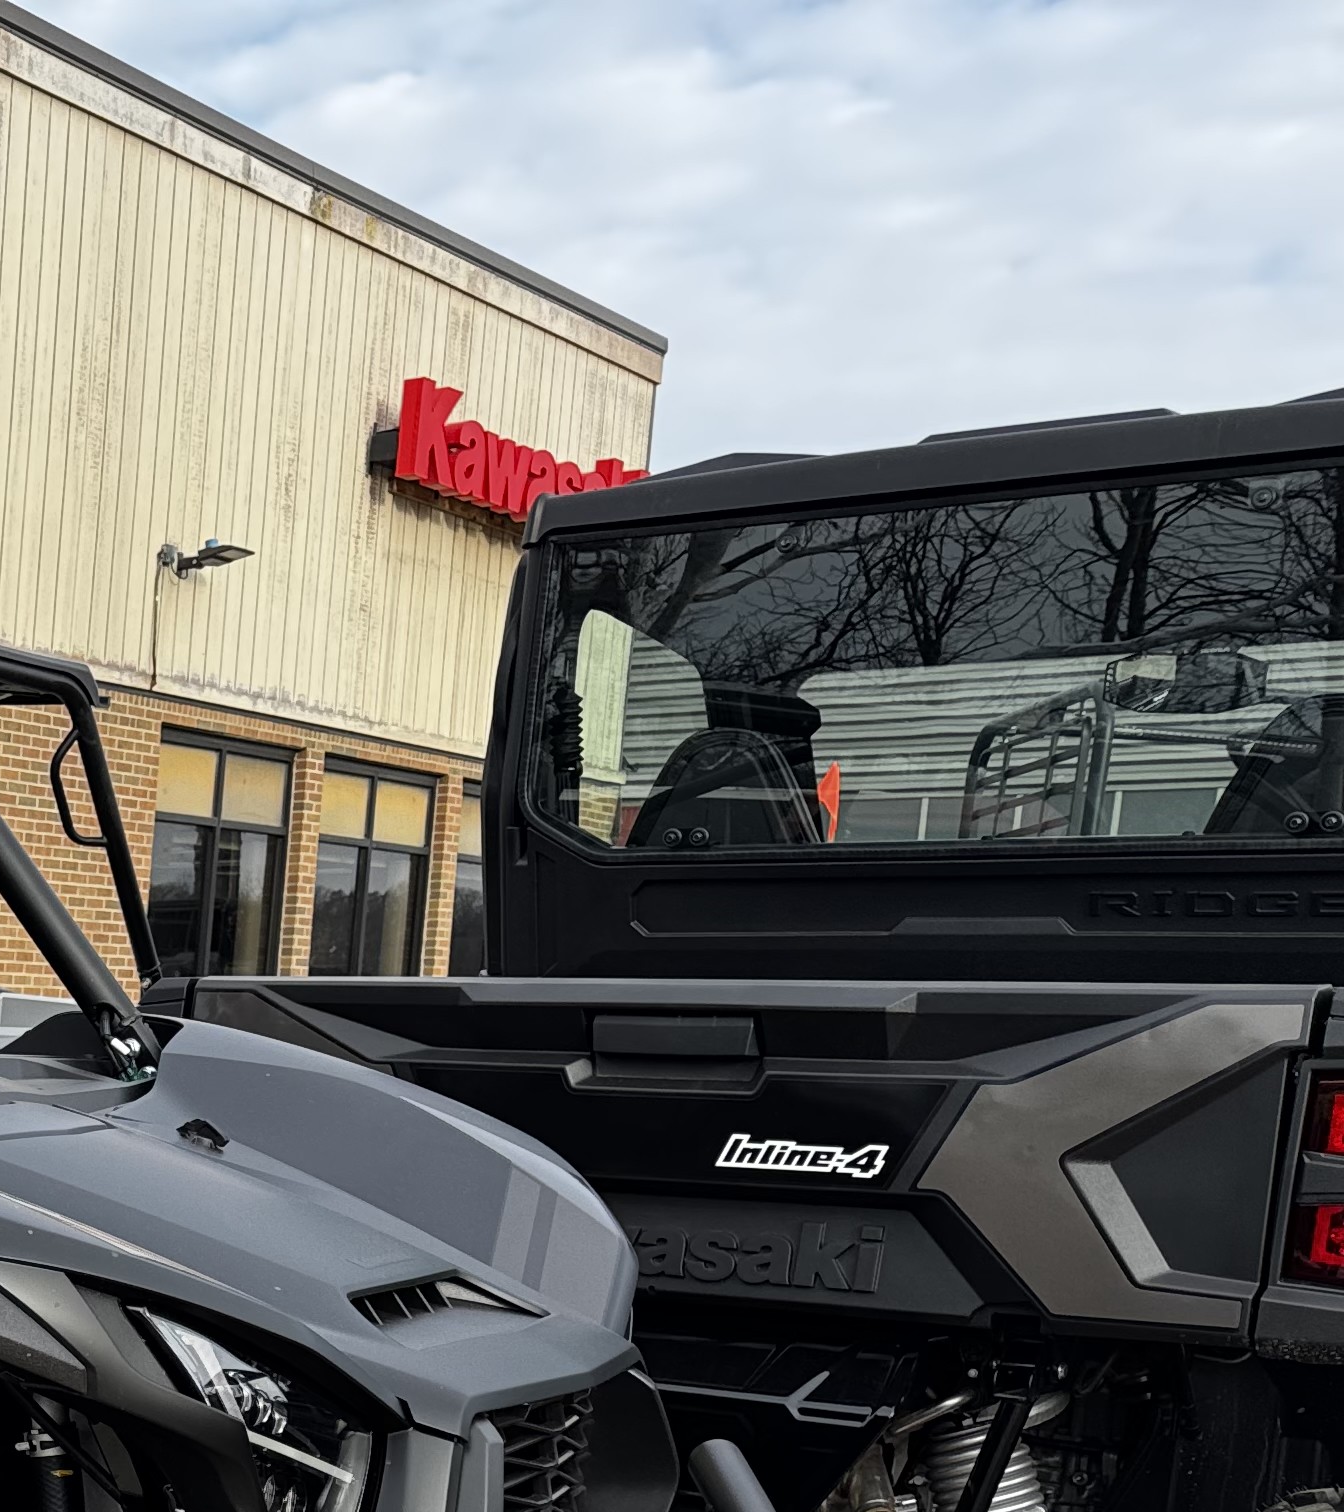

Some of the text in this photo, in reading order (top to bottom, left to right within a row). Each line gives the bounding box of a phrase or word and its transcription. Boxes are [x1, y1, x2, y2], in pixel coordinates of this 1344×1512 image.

[396, 377, 650, 522] Kawas
[715, 1133, 889, 1178] Inline-4
[625, 1222, 885, 1293] asaki
